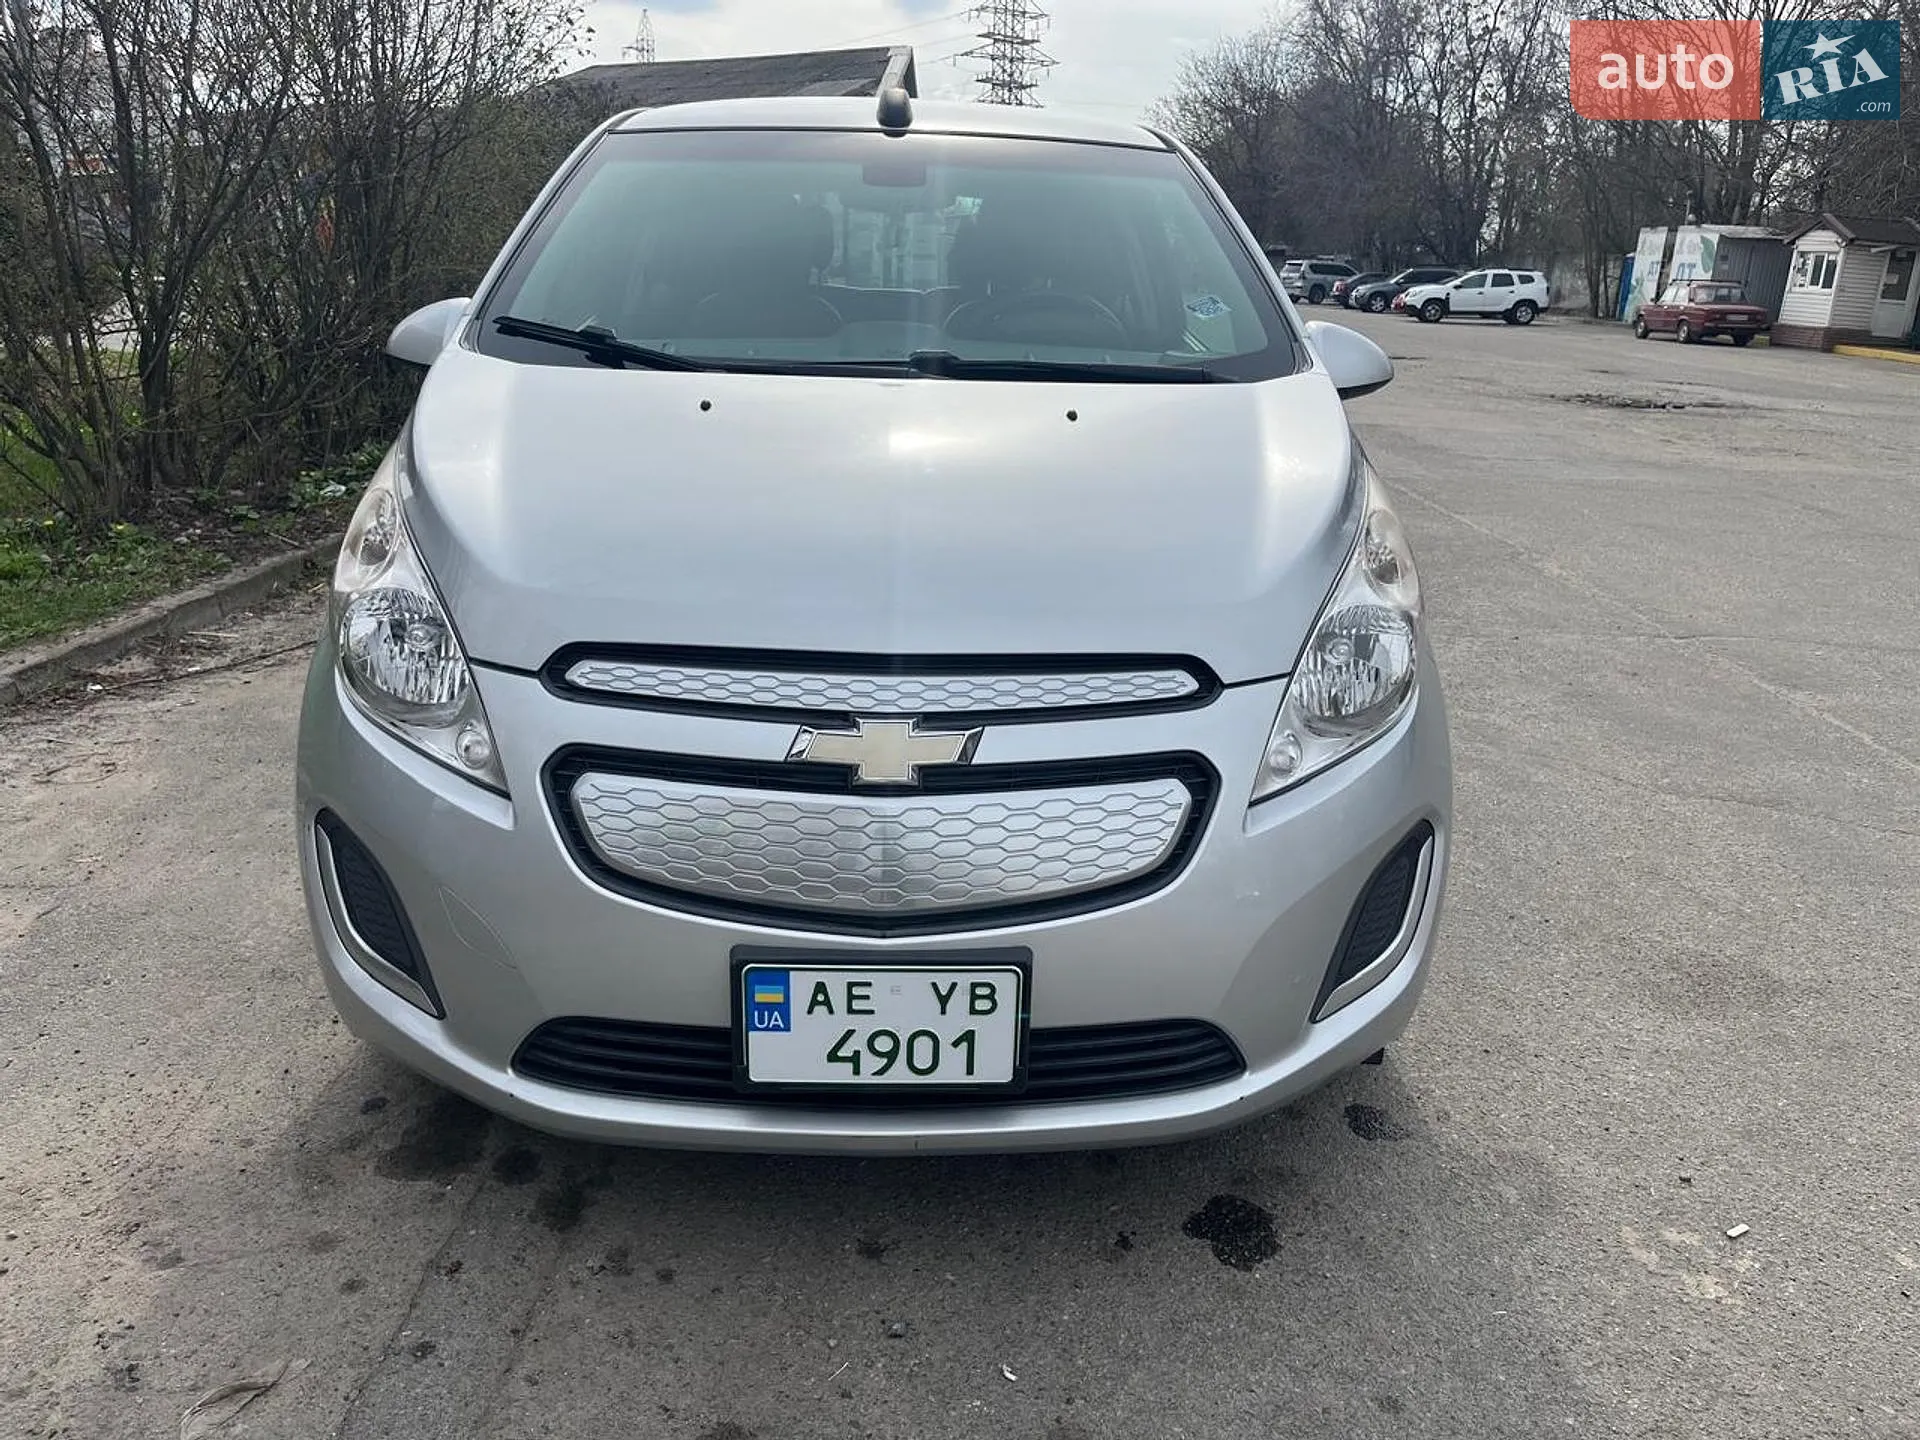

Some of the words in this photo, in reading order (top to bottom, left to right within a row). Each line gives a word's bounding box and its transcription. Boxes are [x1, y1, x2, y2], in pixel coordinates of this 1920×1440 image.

[807, 981, 876, 1015] AE
[931, 981, 998, 1014] YB
[754, 1010, 784, 1029] UA
[827, 1028, 977, 1077] 4901
